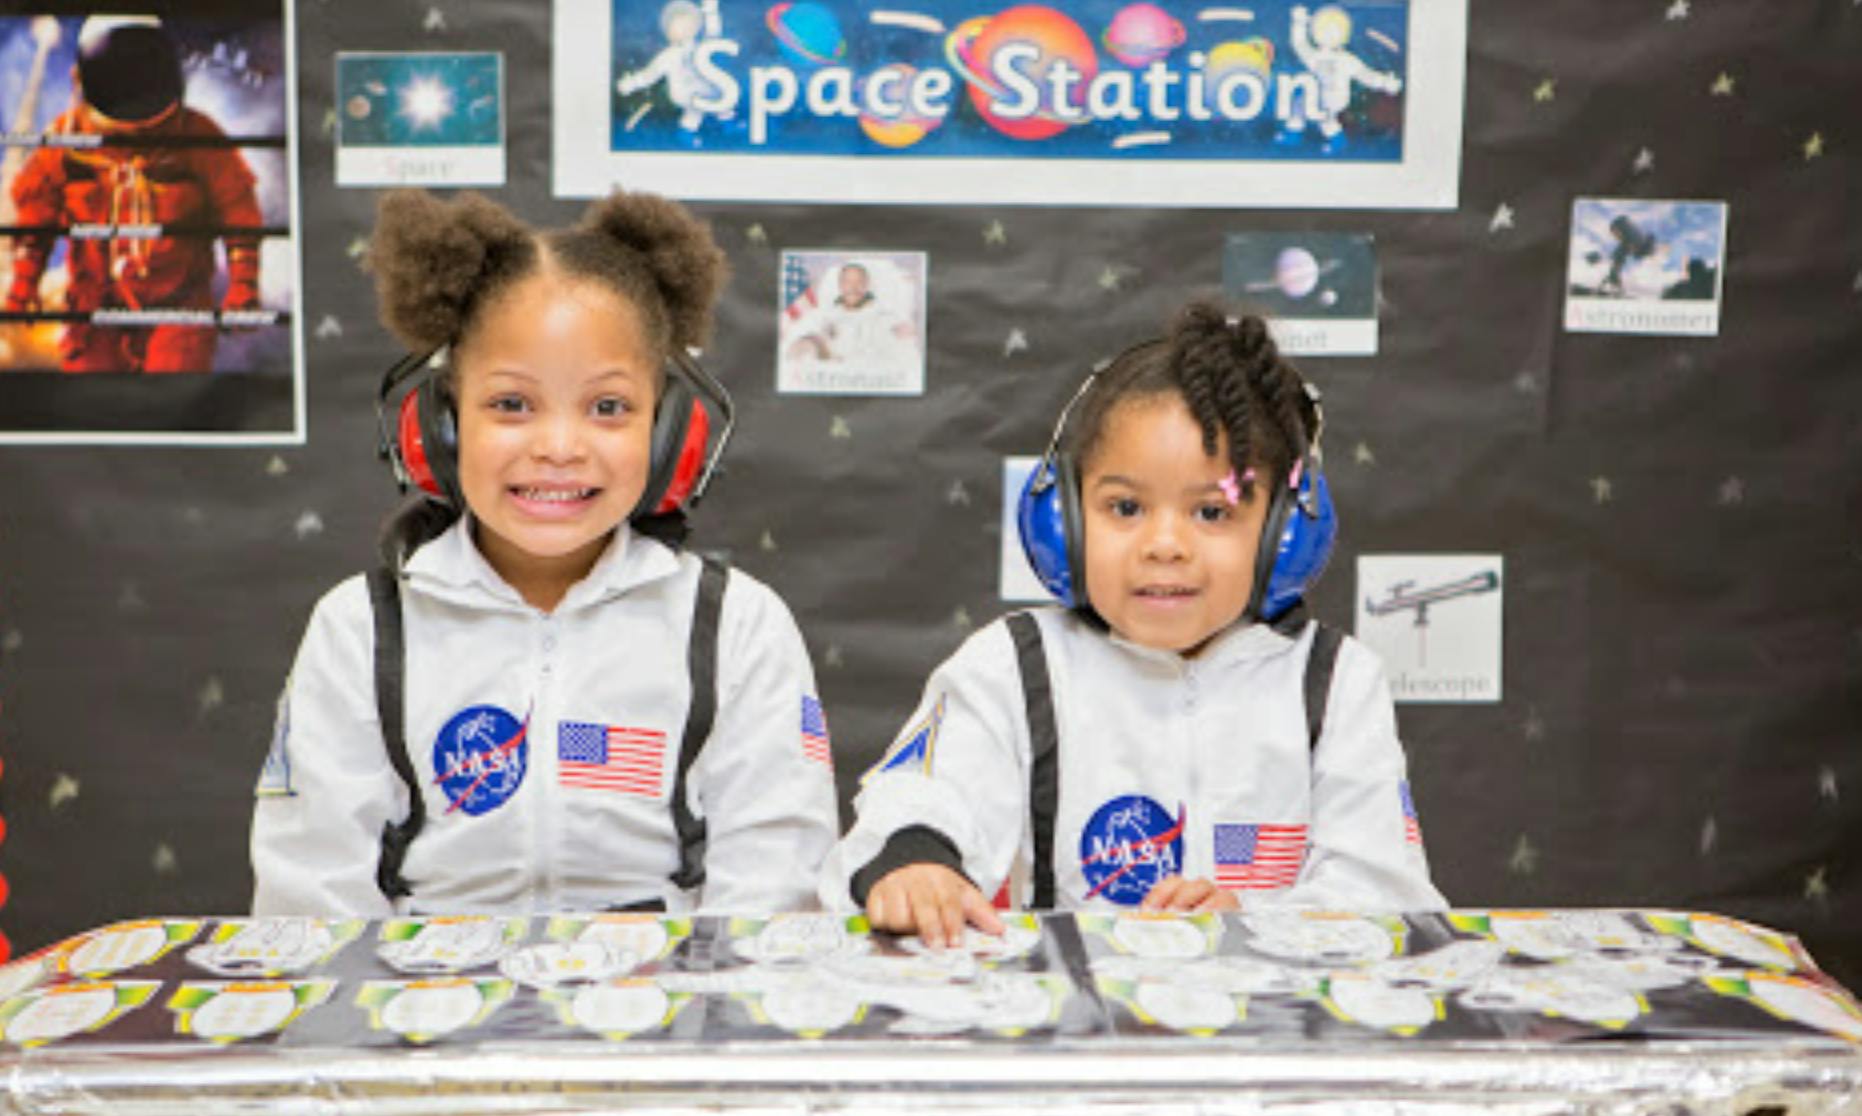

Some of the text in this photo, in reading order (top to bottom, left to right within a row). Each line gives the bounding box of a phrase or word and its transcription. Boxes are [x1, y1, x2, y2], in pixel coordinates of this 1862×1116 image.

[693, 38, 1330, 145] Space Station
[1389, 671, 1491, 699] elescope
[444, 747, 522, 779] NASA
[1092, 835, 1178, 873] NASA
